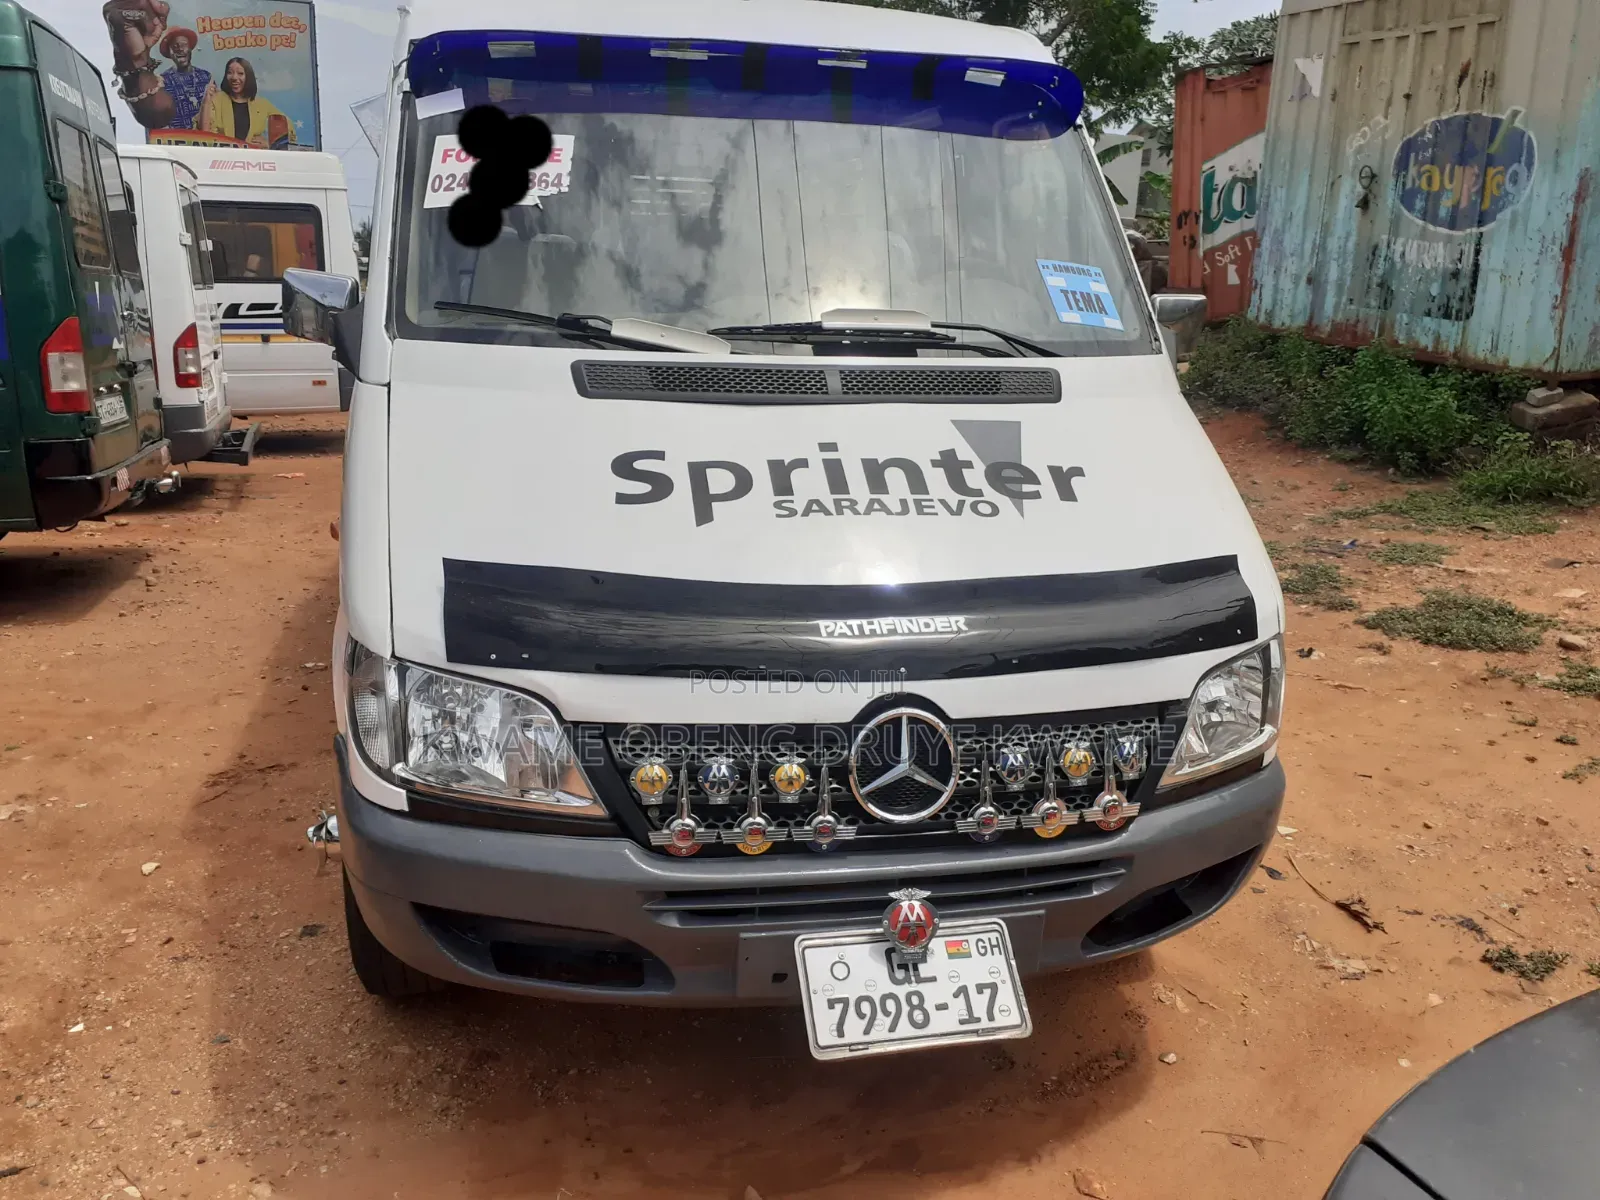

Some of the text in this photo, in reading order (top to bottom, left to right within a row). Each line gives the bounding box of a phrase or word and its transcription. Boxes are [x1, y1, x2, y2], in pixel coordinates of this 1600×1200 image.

[197, 15, 265, 33] Heaven
[213, 31, 267, 51] baako
[1214, 244, 1242, 267] Soft
[1051, 263, 1093, 278] HAMBURG
[1060, 289, 1108, 315] TEMA
[610, 442, 1086, 527] Sprinter
[775, 498, 1000, 518] SARAJEVO
[818, 615, 968, 638] PATHFINDER
[975, 937, 1003, 957] GH
[827, 981, 999, 1038] 7998-17
